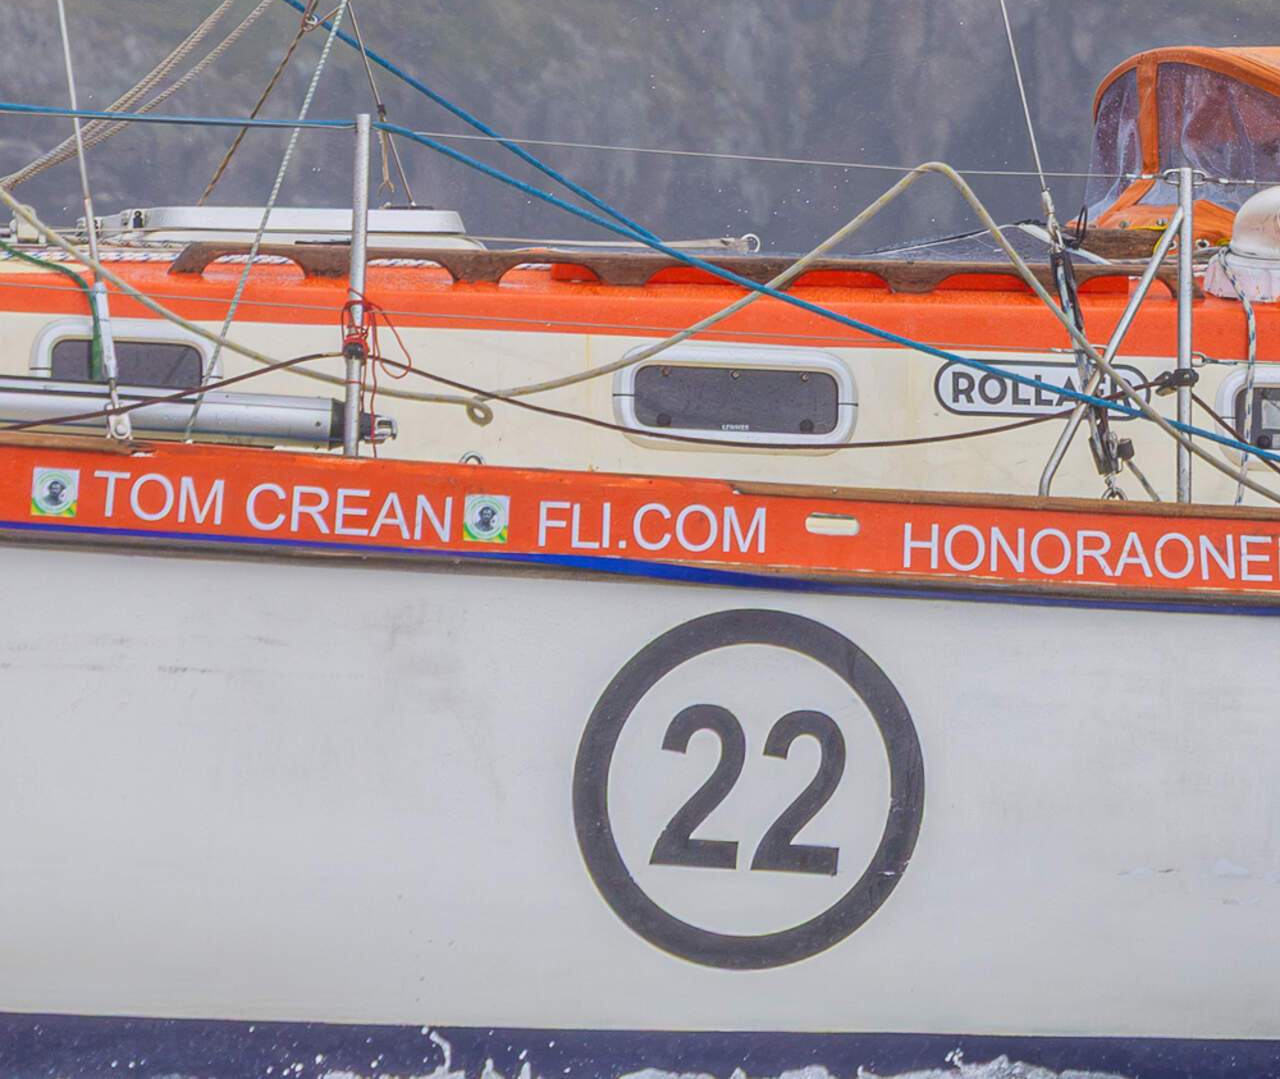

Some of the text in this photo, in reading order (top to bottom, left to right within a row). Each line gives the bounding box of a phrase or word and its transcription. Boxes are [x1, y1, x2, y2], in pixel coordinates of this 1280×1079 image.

[93, 470, 226, 525] TOM
[245, 483, 452, 543] CREAN
[537, 500, 767, 554] FLI.COM
[649, 703, 848, 877] 22
